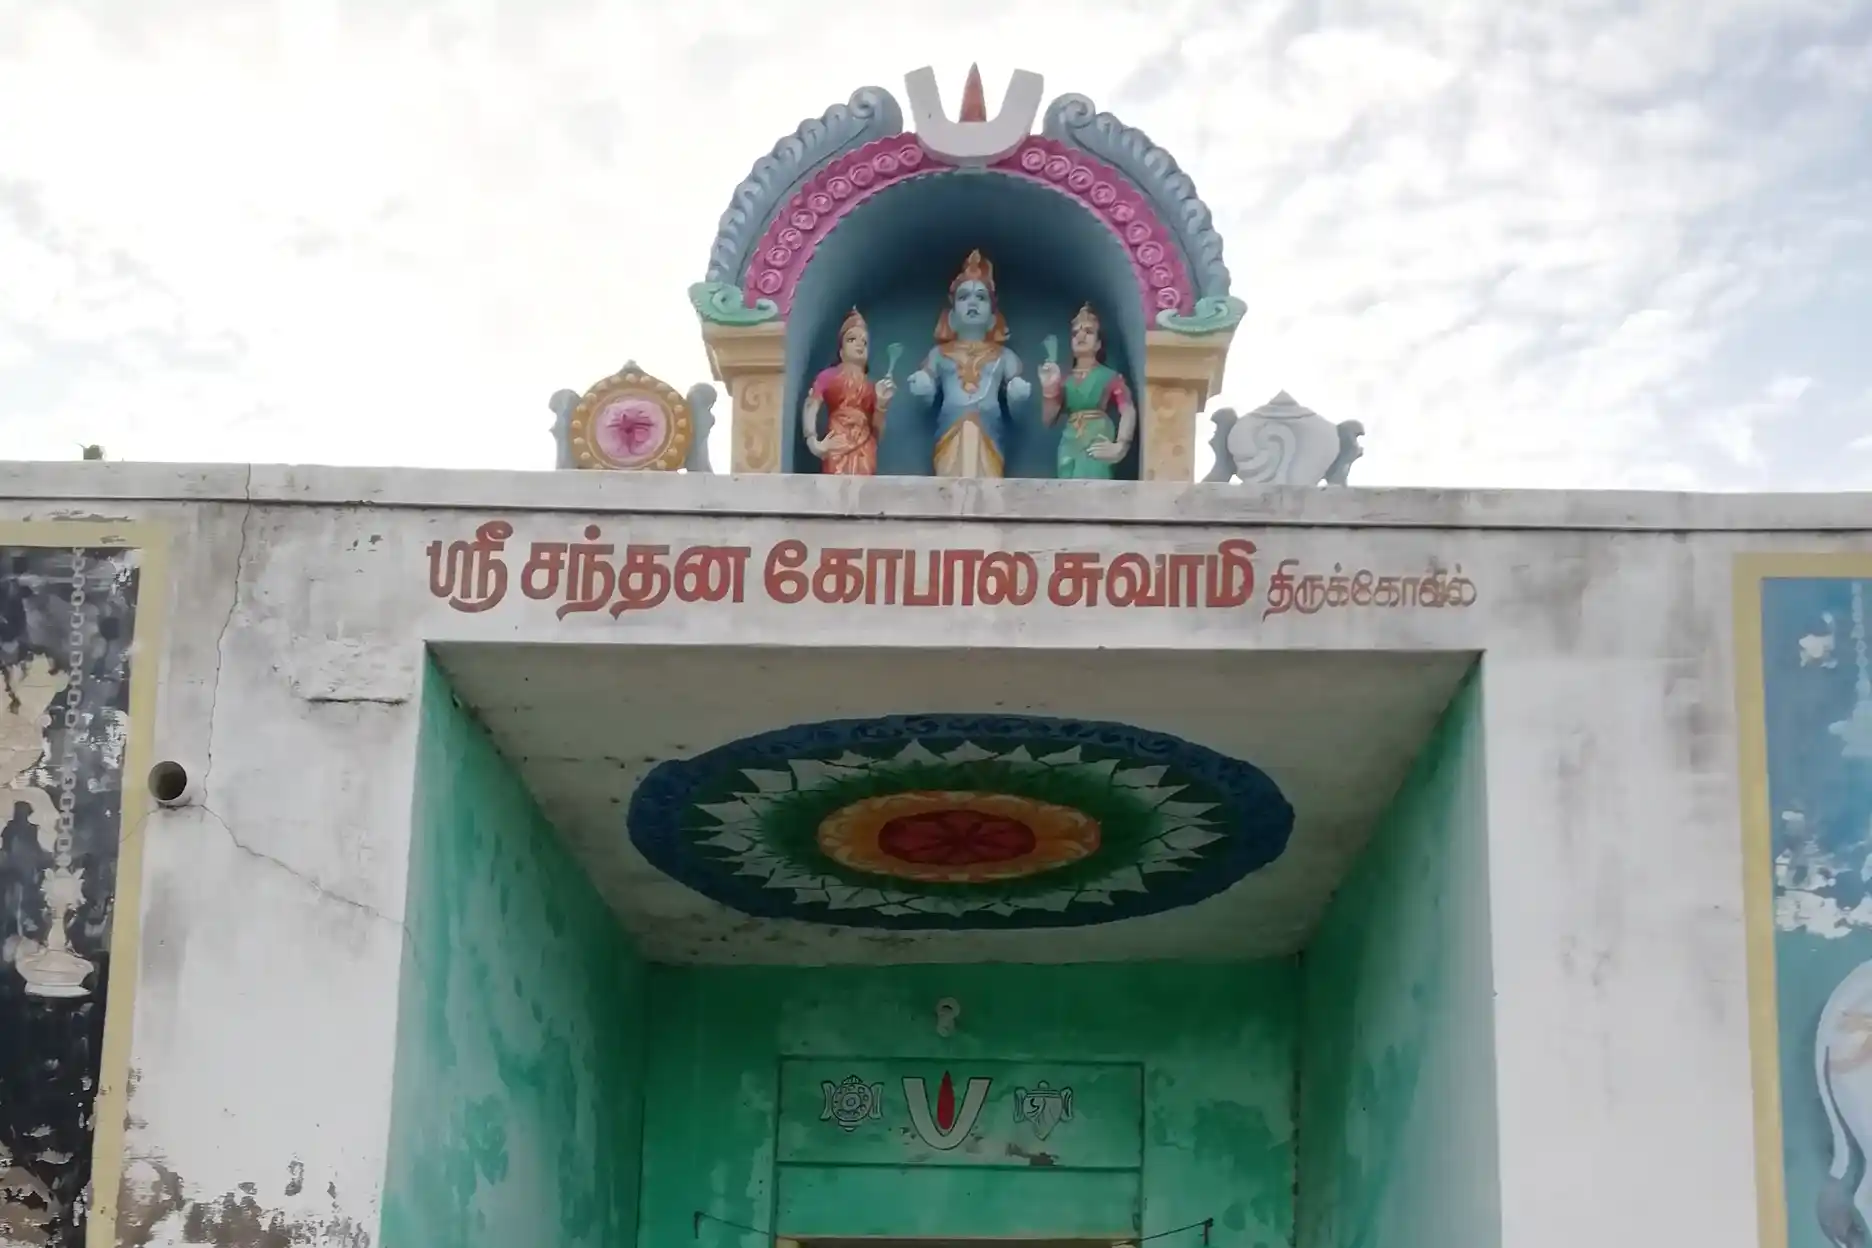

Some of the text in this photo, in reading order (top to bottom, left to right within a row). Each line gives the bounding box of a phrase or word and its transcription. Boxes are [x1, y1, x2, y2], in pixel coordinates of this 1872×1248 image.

[427, 520, 514, 613] ஸ்ரீ
[521, 524, 752, 621] சந்தன
[763, 539, 1039, 608] கோபால
[1047, 538, 1257, 608] சுவாமி
